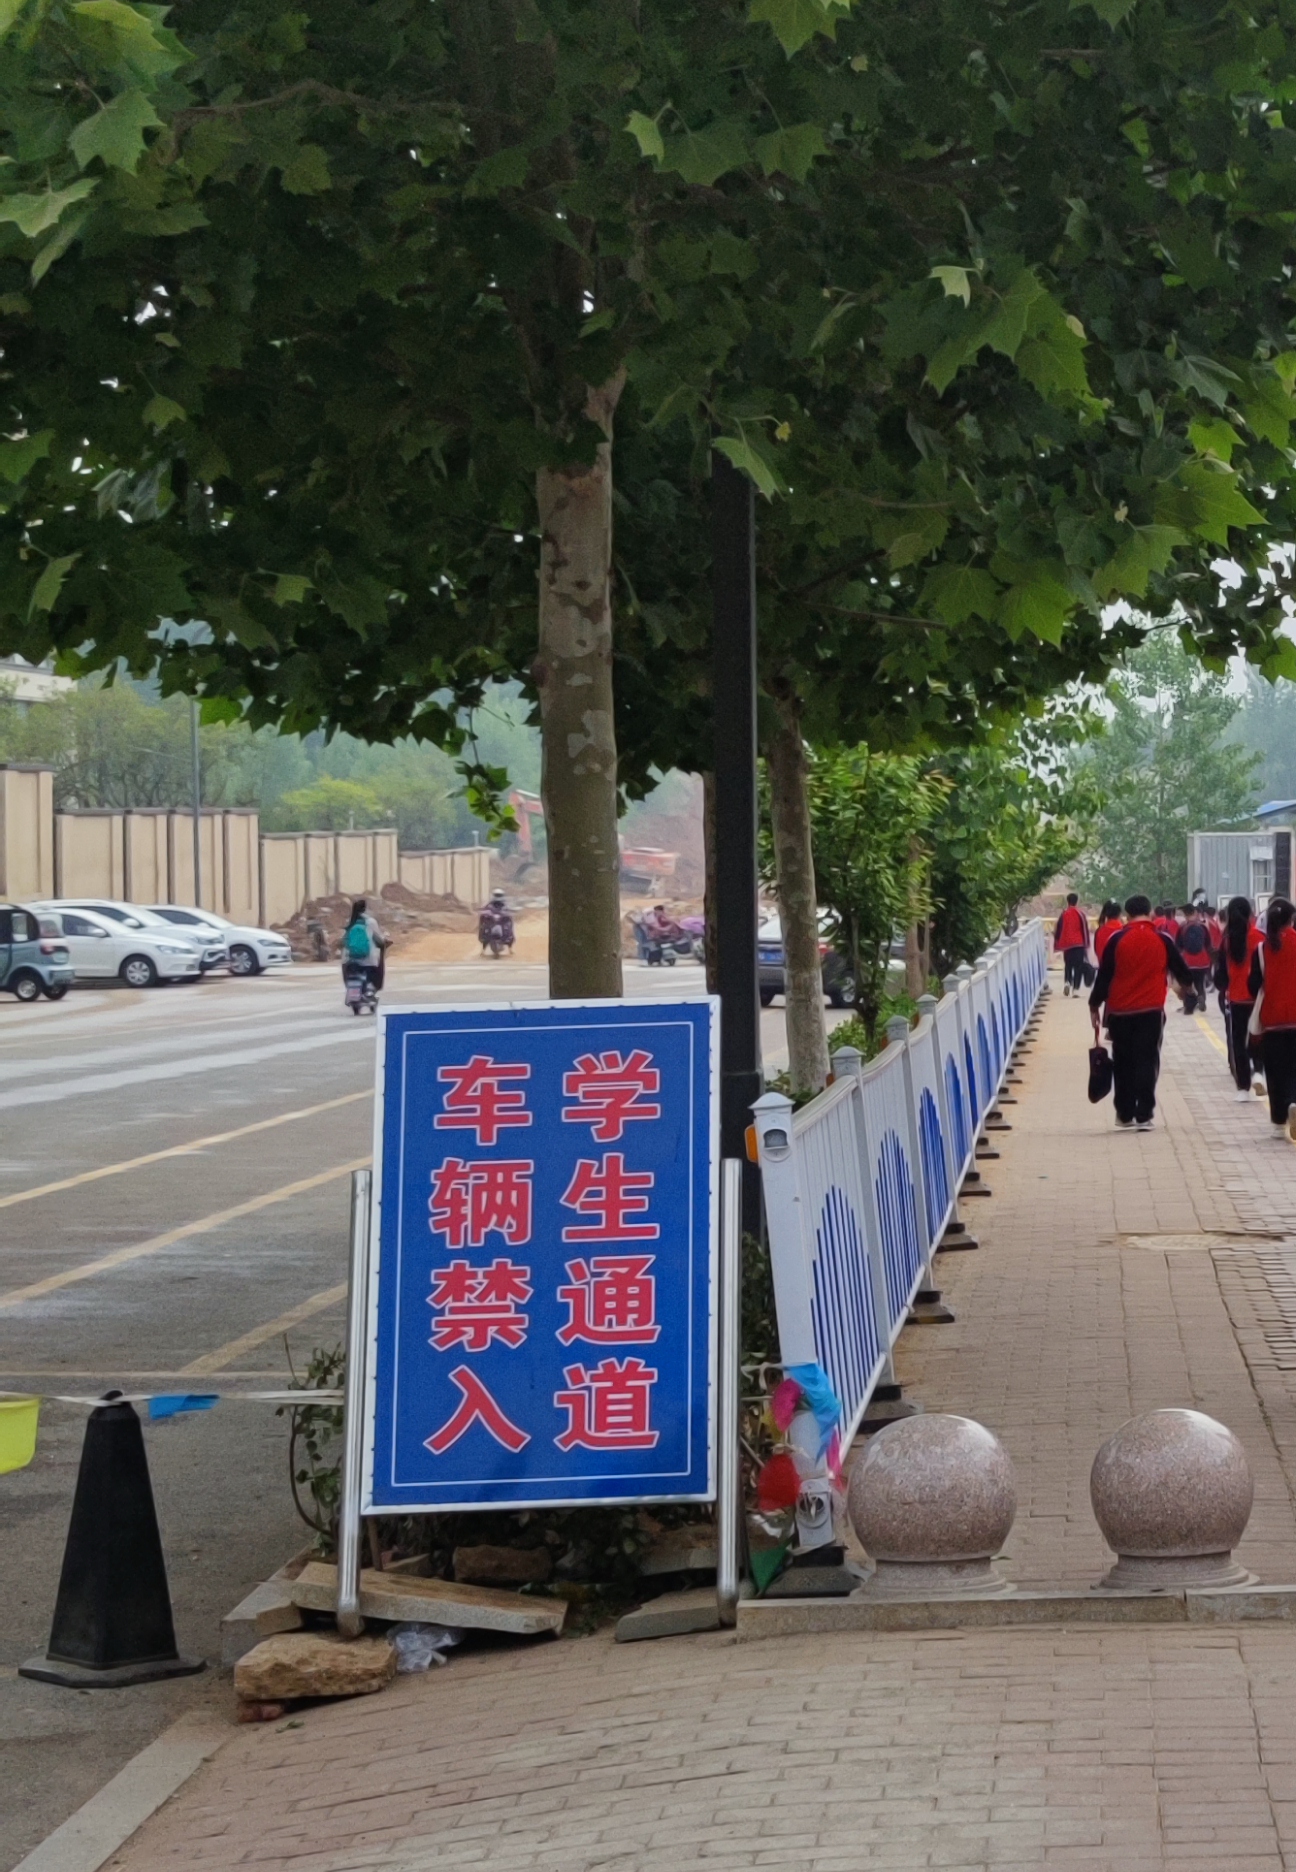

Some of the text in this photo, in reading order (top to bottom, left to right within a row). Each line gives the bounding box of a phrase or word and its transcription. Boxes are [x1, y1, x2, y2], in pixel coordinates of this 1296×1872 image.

[424, 1055, 534, 1455] 车辆禁入
[554, 1049, 661, 1451] 学生通道
